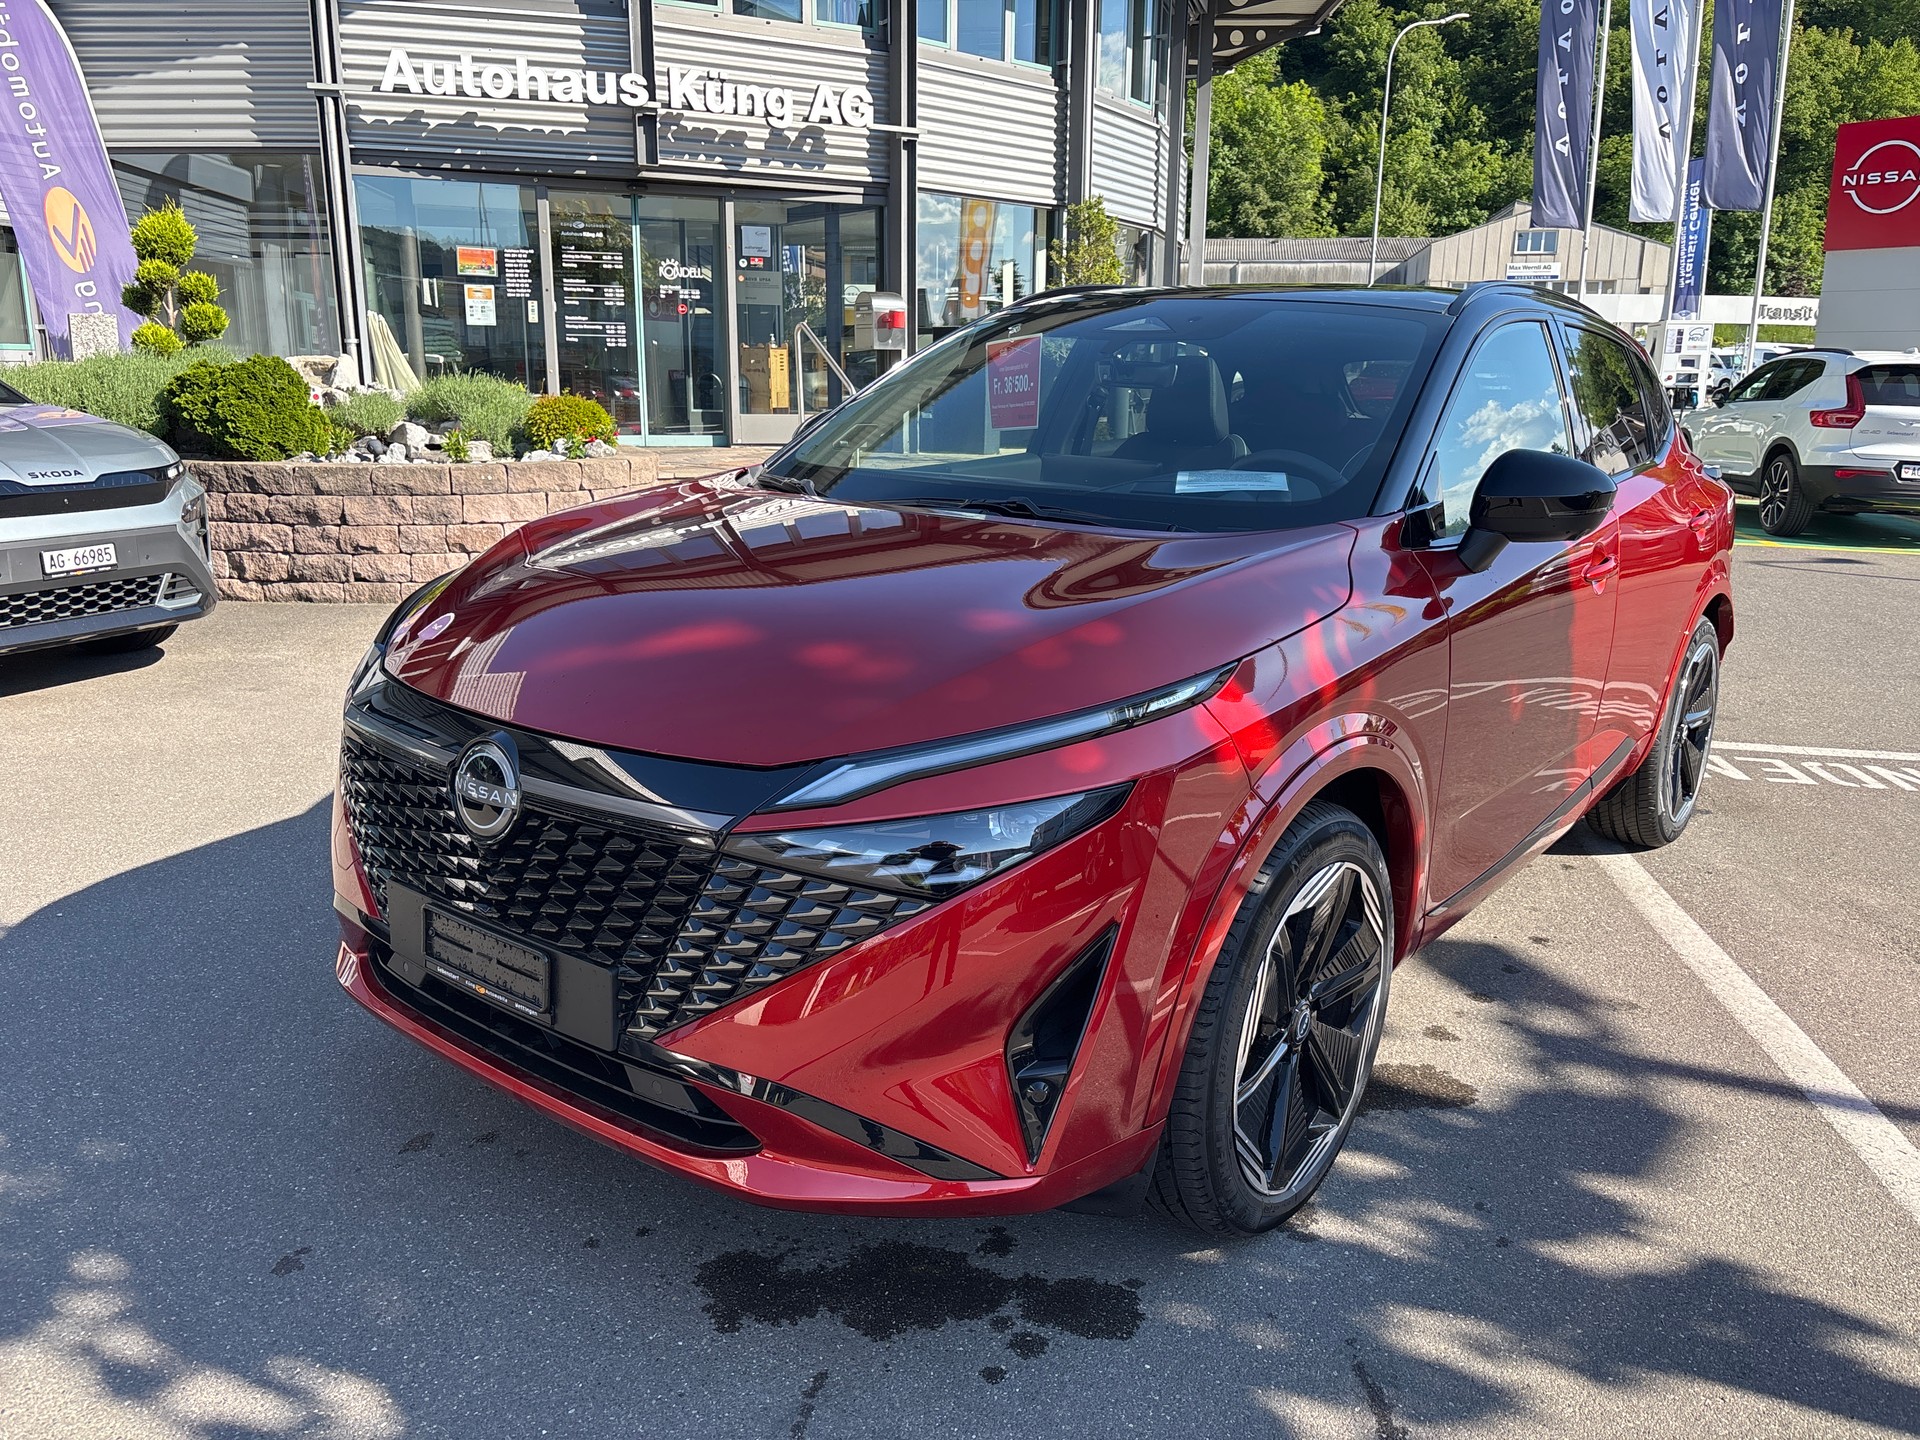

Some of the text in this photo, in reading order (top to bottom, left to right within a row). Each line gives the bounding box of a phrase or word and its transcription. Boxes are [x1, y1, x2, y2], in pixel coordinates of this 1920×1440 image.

[379, 47, 875, 128] Autohaus Küng AG
[1842, 169, 1920, 187] NISSA
[1758, 304, 1813, 320] Transit
[993, 378, 1003, 395] Fr.
[50, 553, 65, 570] AG
[73, 546, 113, 567] 66985
[456, 776, 518, 806] NISSAN
